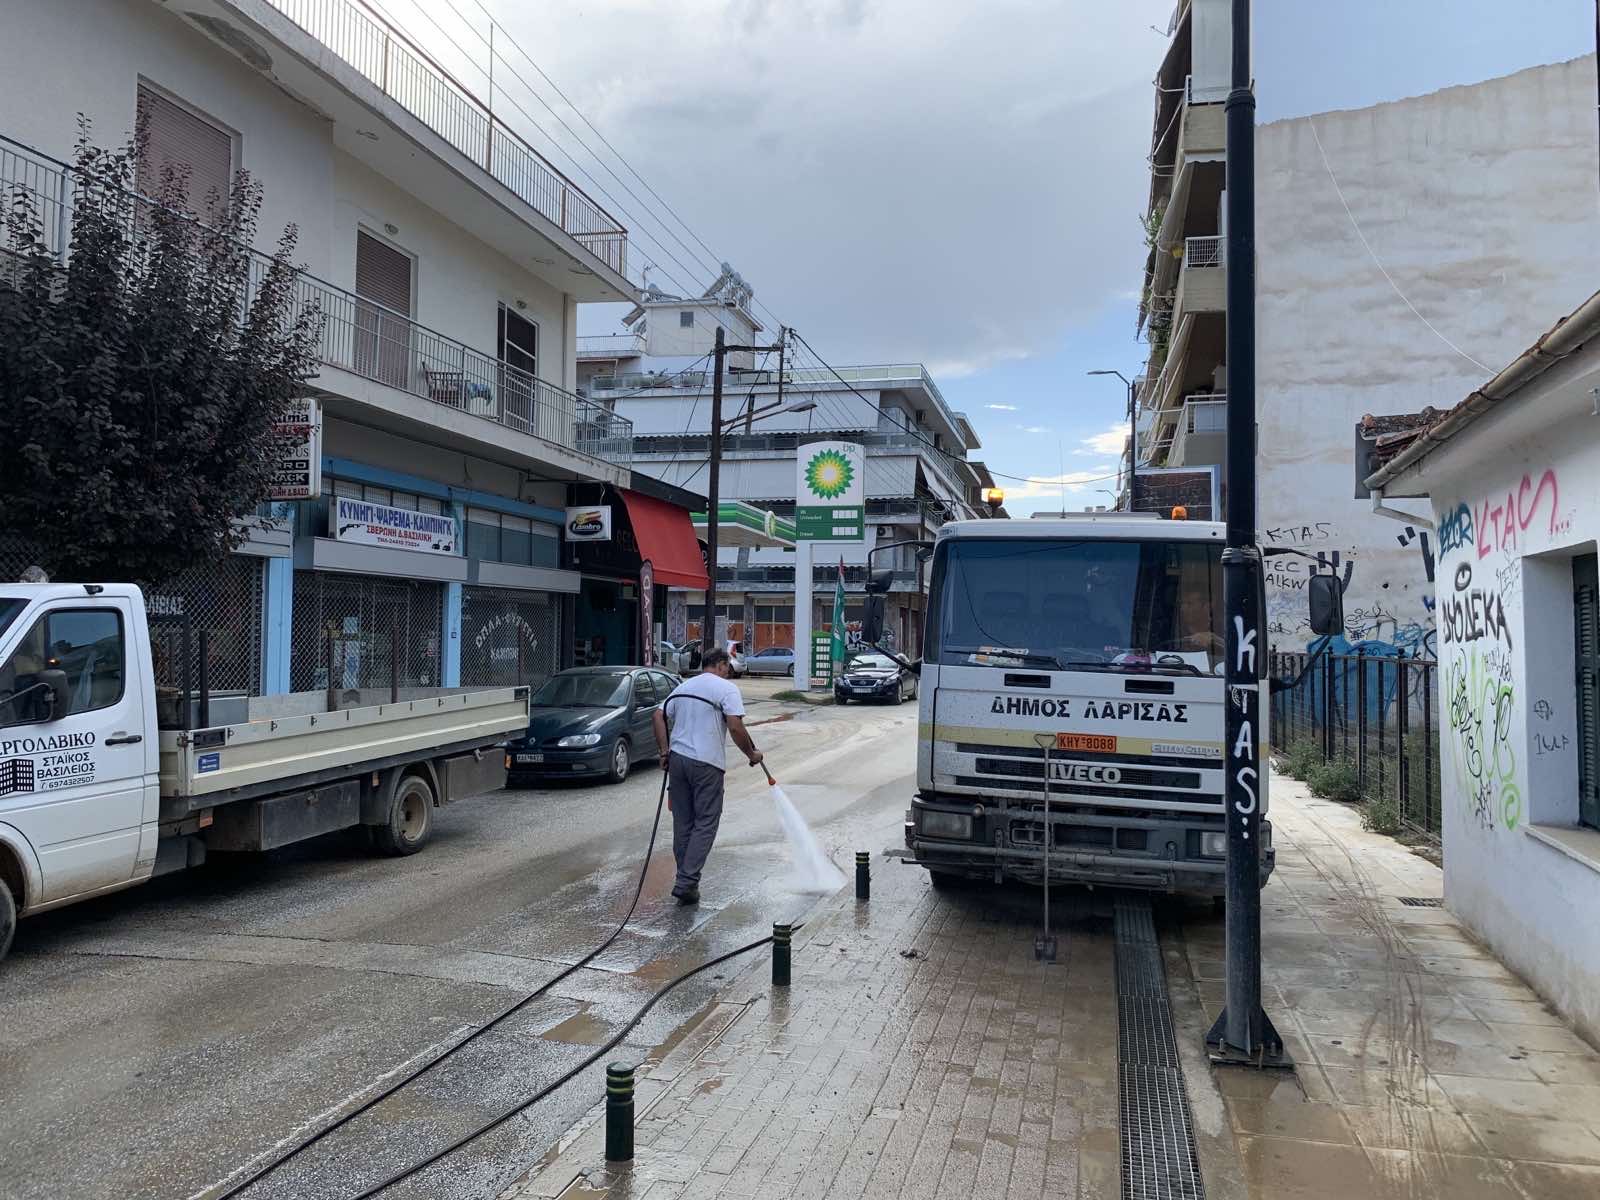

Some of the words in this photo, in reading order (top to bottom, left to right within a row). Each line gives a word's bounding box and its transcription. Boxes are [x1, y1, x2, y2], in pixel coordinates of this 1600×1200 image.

[990, 696, 1070, 718] ΔΗΜΟΣ
[1084, 701, 1188, 723] ΛΑΡΙΣΑΣ
[0, 731, 96, 756] ΡΓΟΛΑΒΙΚΟ
[42, 751, 90, 767] ΣΤΑΪΚΟΣ
[37, 762, 96, 779] ΒΑΣΙΛΕΙΟΣ
[1050, 763, 1122, 784] IVECO
[48, 775, 95, 789] 6974322507
